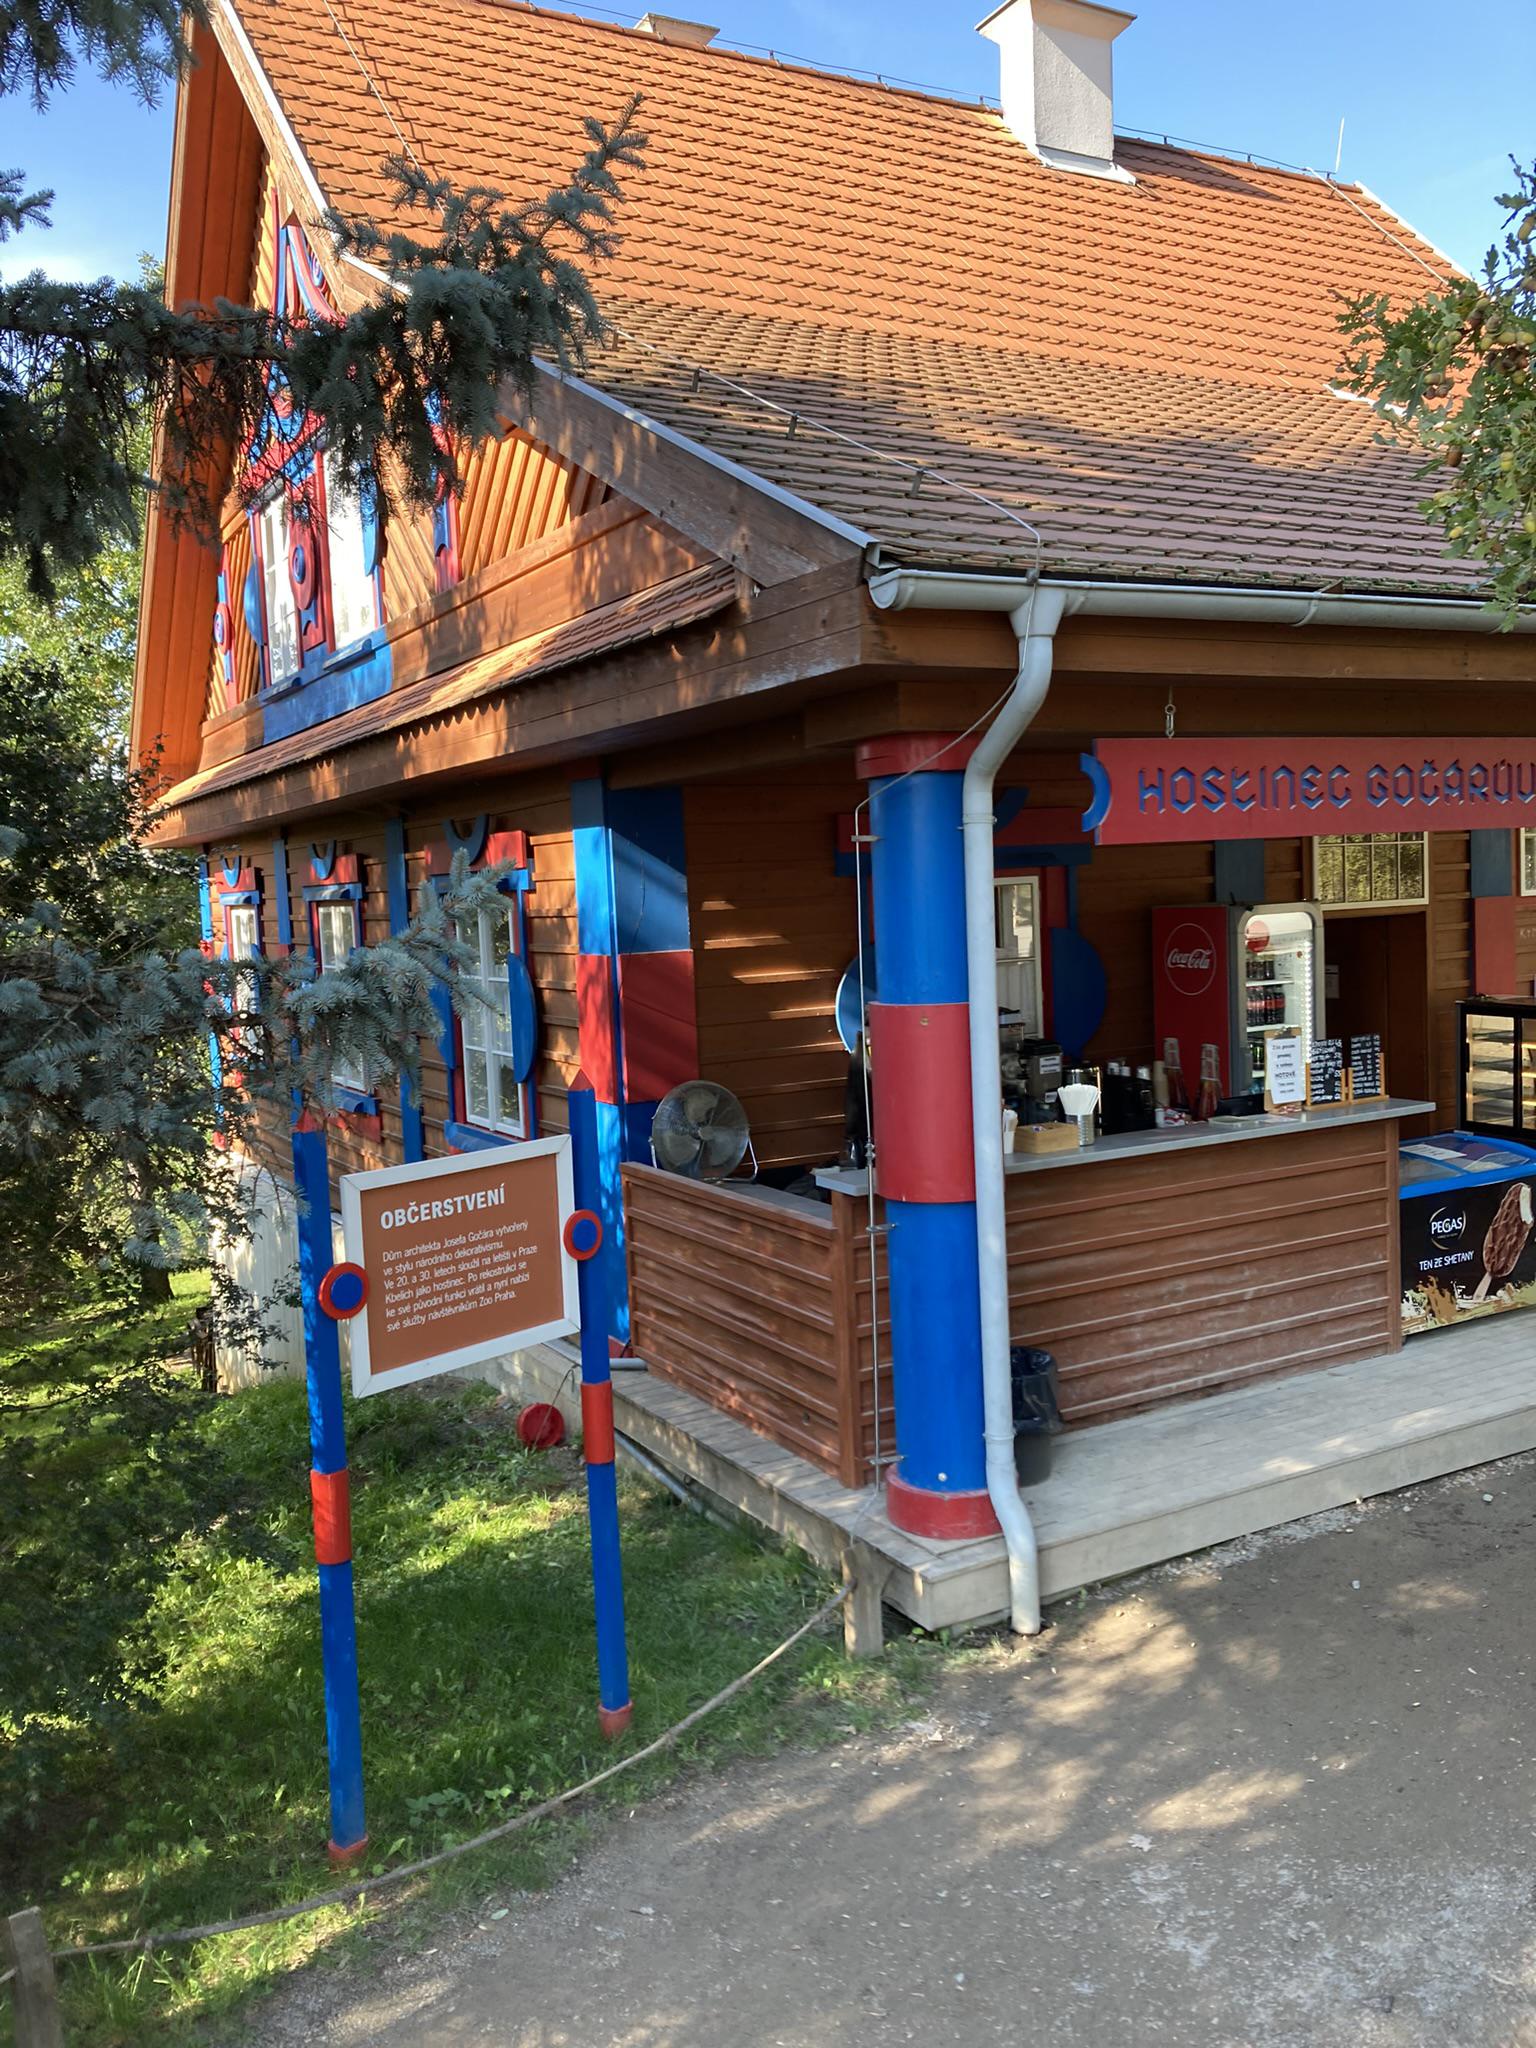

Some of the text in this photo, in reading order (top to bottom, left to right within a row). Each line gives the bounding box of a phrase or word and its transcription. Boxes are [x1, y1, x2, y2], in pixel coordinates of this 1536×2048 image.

[1137, 763, 1351, 815] HOSTINEC
[1167, 947, 1212, 969] Coca-Cola
[380, 1183, 505, 1230] OBČERSTVENÍ
[1431, 1216, 1463, 1235] PEGAS
[382, 1220, 529, 1262] Dům architekta Josefa Gočára vytvořený
[1418, 1250, 1475, 1271] TEN ZE SMETANY
[383, 1267, 393, 1276] ve
[395, 1260, 414, 1275] stylu
[415, 1250, 453, 1268] národního
[384, 1244, 538, 1290] Ve 20. a 30. letech sloužil na letišti v Praze
[385, 1288, 414, 1304] Kbelích
[415, 1283, 431, 1298] jako
[433, 1276, 466, 1291] hostinec.
[467, 1272, 478, 1283] Po
[518, 1261, 527, 1270] se
[385, 1272, 530, 1319] ke své původní funkci vrátil a nyní nabízí
[386, 1320, 400, 1332] své
[402, 1311, 426, 1328] služby
[428, 1300, 478, 1321] návštěvníkům
[479, 1296, 493, 1307] Zoo
